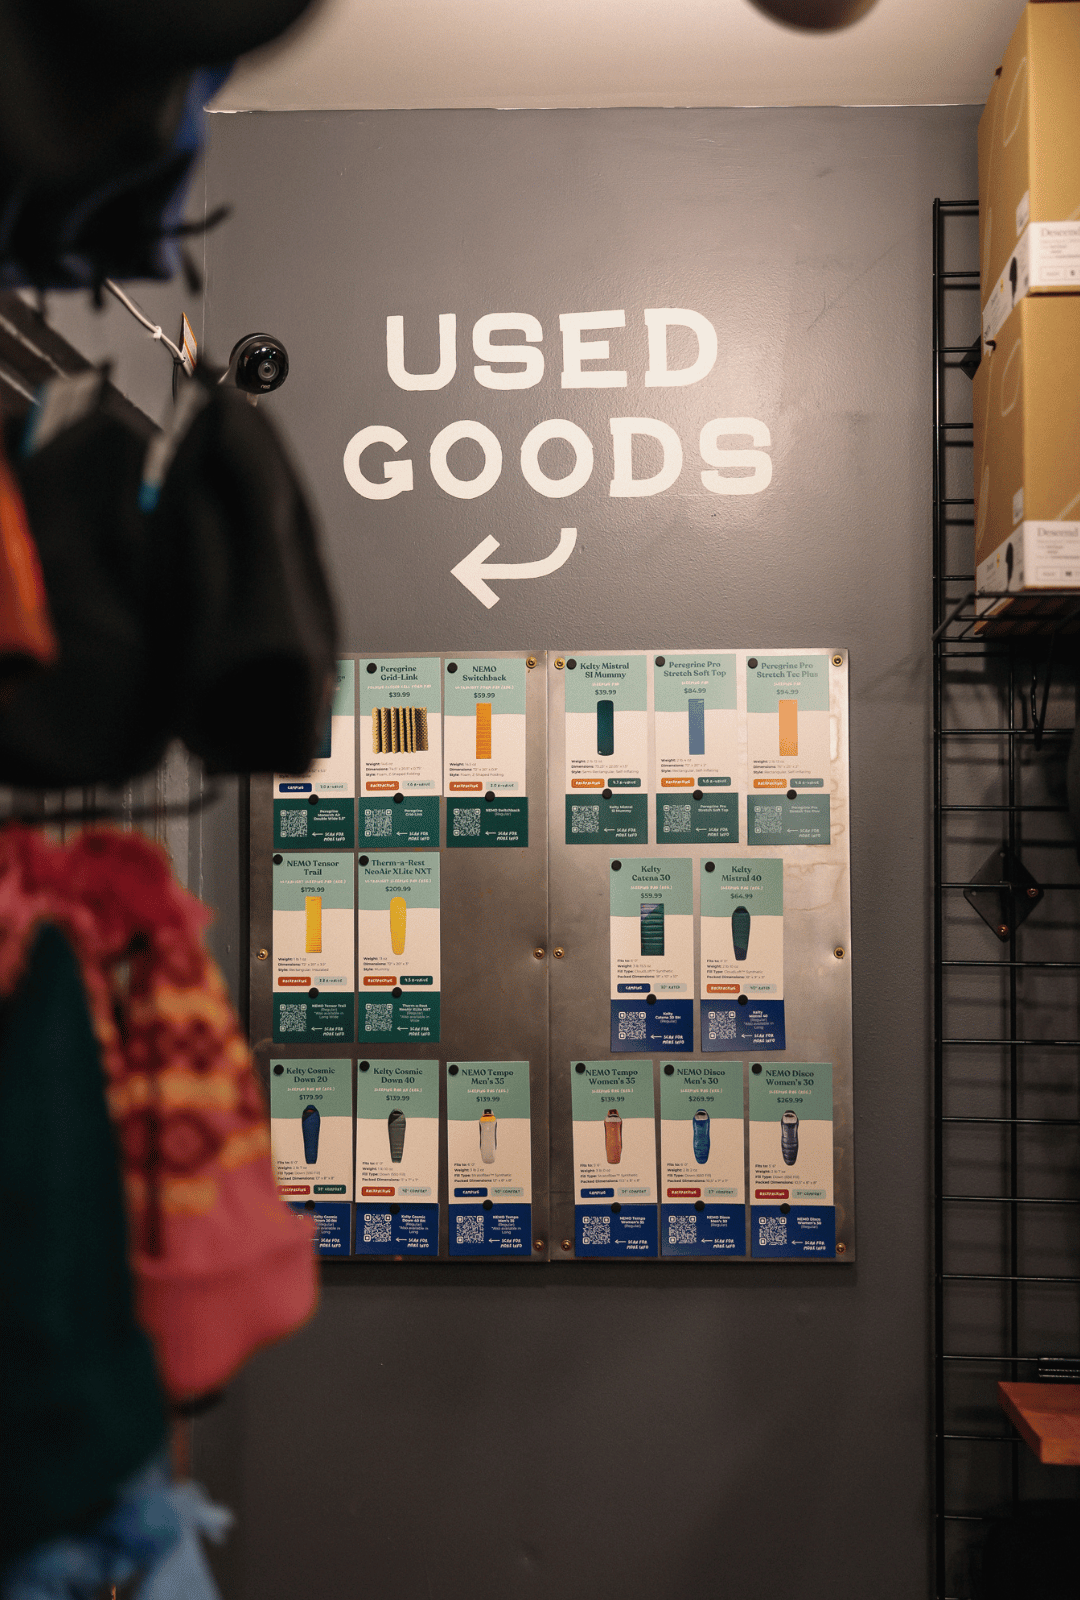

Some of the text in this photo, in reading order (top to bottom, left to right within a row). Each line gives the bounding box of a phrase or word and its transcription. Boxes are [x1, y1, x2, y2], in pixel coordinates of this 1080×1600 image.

[386, 307, 719, 391] USED
[343, 416, 774, 501] GOODS
[380, 665, 417, 674] Peregrine
[580, 662, 600, 671] Kelty
[669, 661, 706, 669] Peregrine
[761, 662, 798, 670] Peregrine
[711, 670, 726, 678] Top
[641, 865, 661, 874] Kelty
[731, 865, 752, 874] Kelty
[286, 1067, 306, 1076] Kelty
[373, 1068, 394, 1076] Kelty
[488, 1069, 514, 1077] Tempo
[612, 1069, 638, 1077] Tempo
